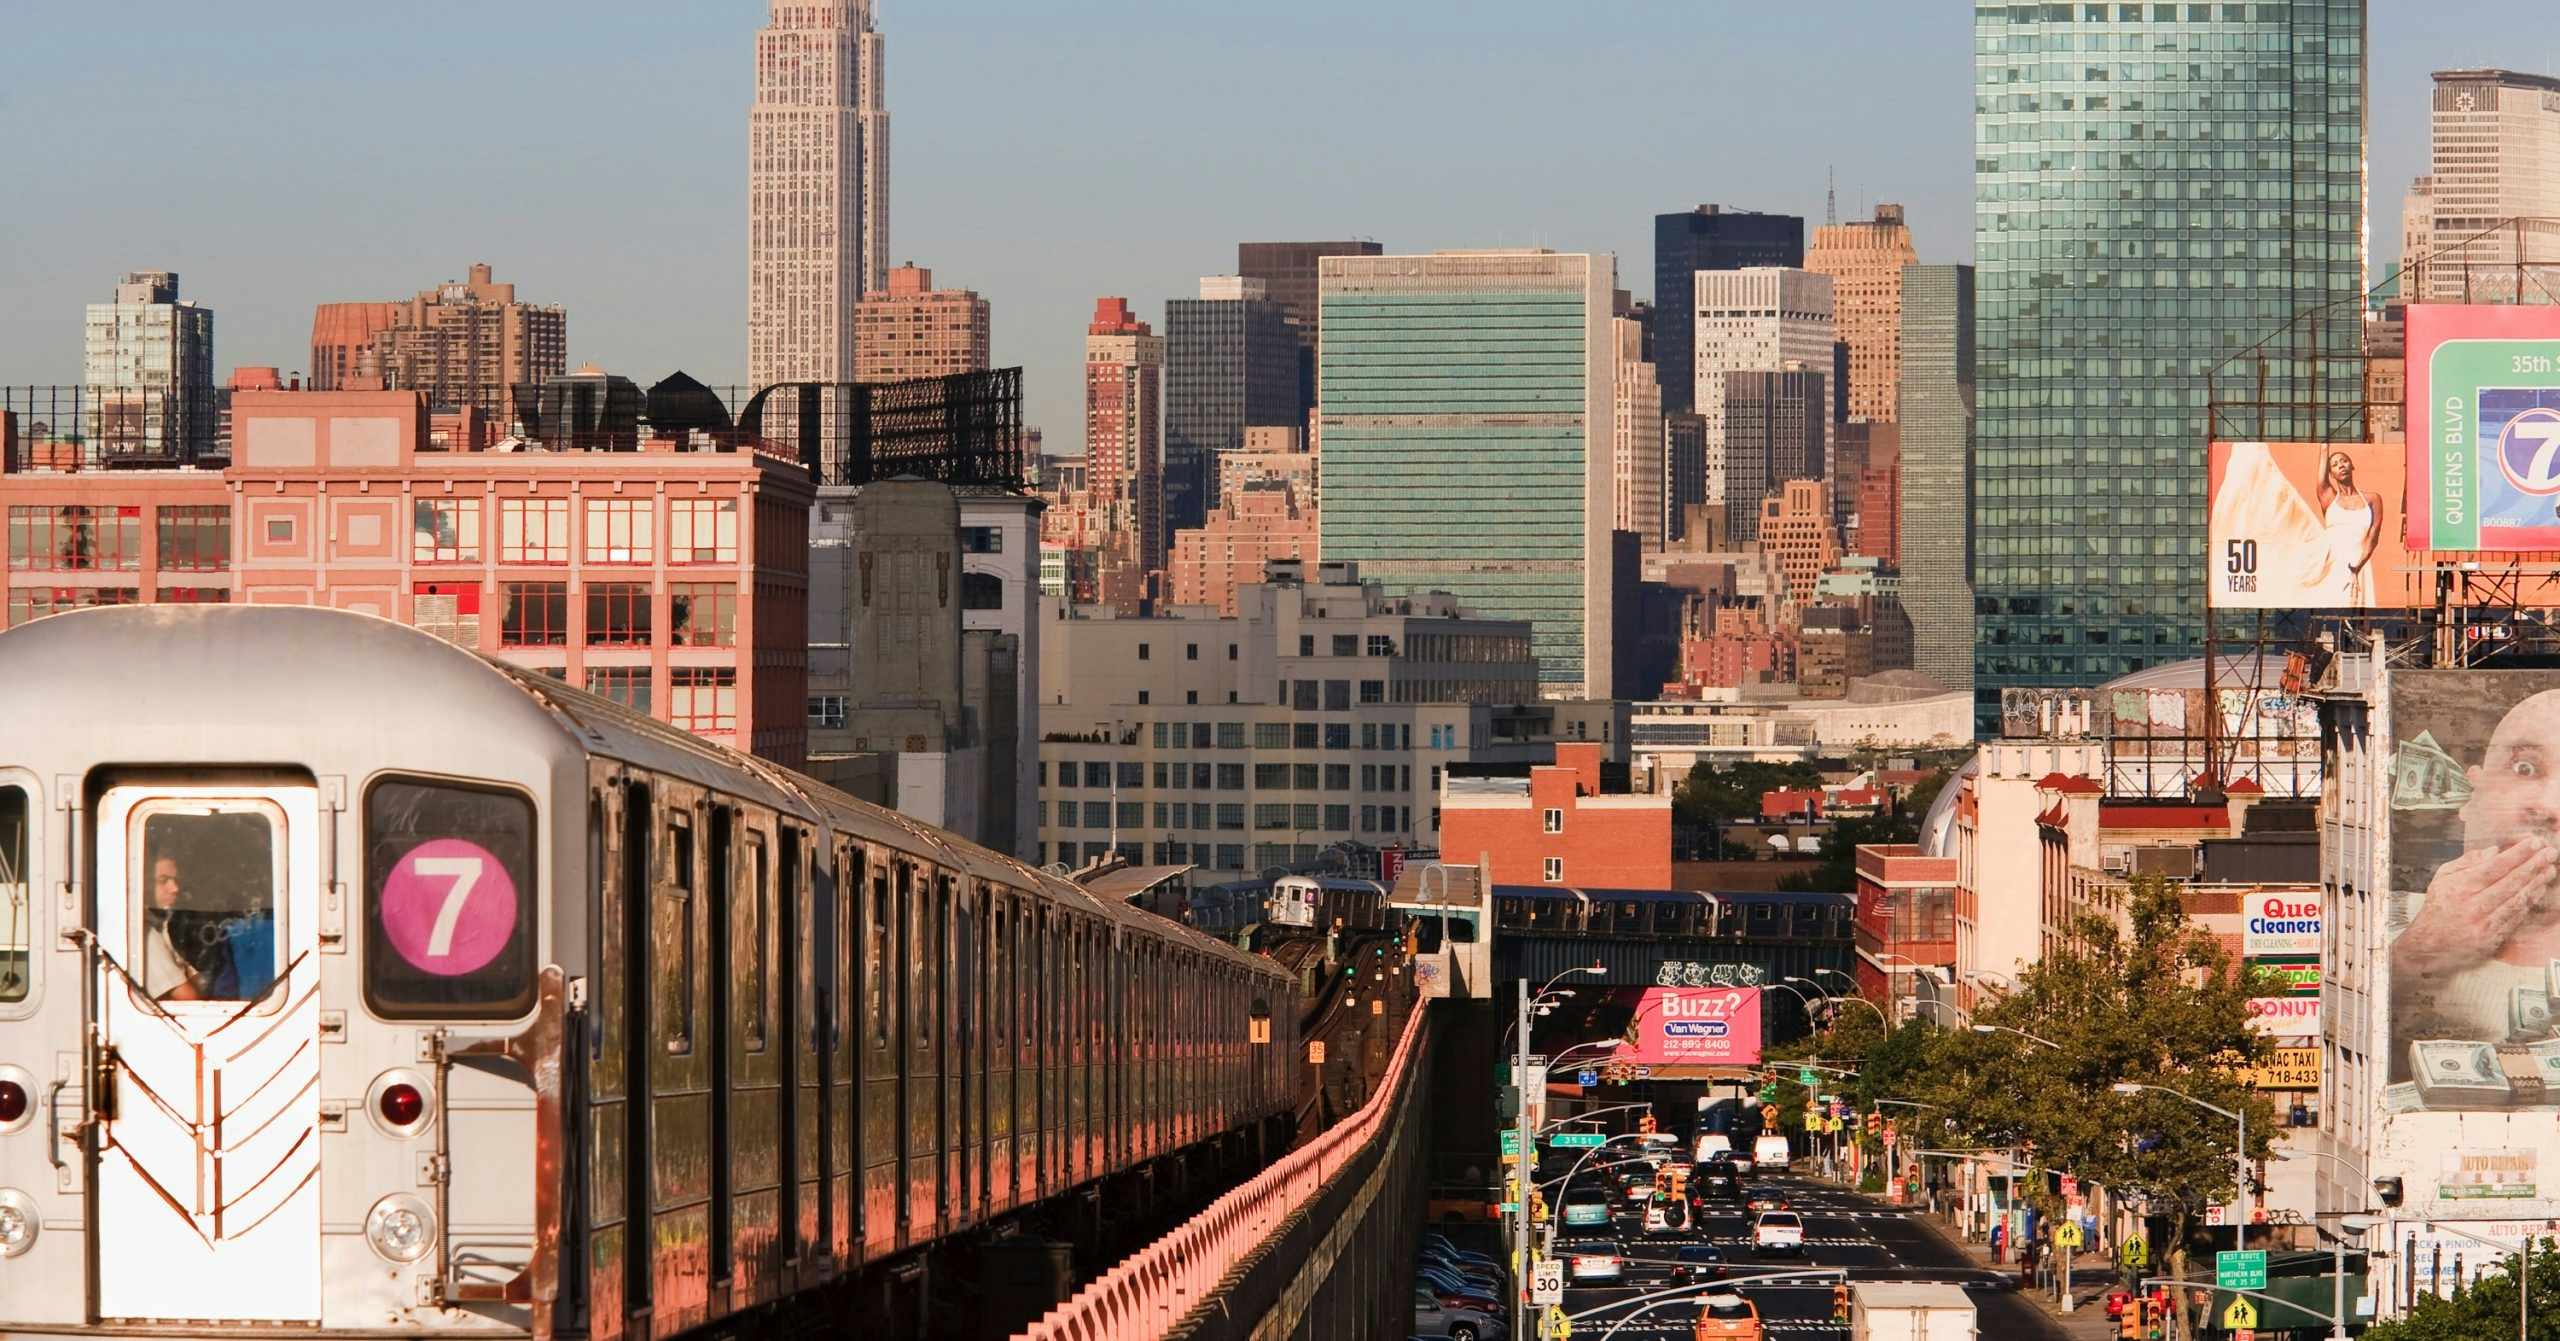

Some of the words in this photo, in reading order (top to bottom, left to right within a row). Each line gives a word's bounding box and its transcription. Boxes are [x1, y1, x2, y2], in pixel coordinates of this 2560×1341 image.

[2511, 355, 2551, 373] 35th
[2445, 396, 2463, 444] BLVD
[2514, 421, 2560, 489] 7
[2445, 451, 2463, 525] QUEENS
[2227, 539, 2257, 574] 50
[2228, 576, 2257, 593] YEARS
[414, 857, 483, 956] 7
[2263, 898, 2321, 918] Que
[2250, 918, 2320, 934] Cleaners
[2263, 938, 2293, 948] CLEANING
[1662, 992, 1741, 1017] Buzz?
[1667, 1024, 1688, 1033] Van
[1688, 1024, 1725, 1036] Wagner
[2293, 1052, 2315, 1067] TAXI
[1581, 1136, 1592, 1144] St
[2460, 1155, 2489, 1171] AUTO
[2488, 1224, 2518, 1236] AUTO
[2445, 1239, 2481, 1249] PINION
[2240, 1252, 2260, 1260] ROUTE
[2238, 1262, 2246, 1270] TO
[1536, 1278, 1559, 1291] 30
